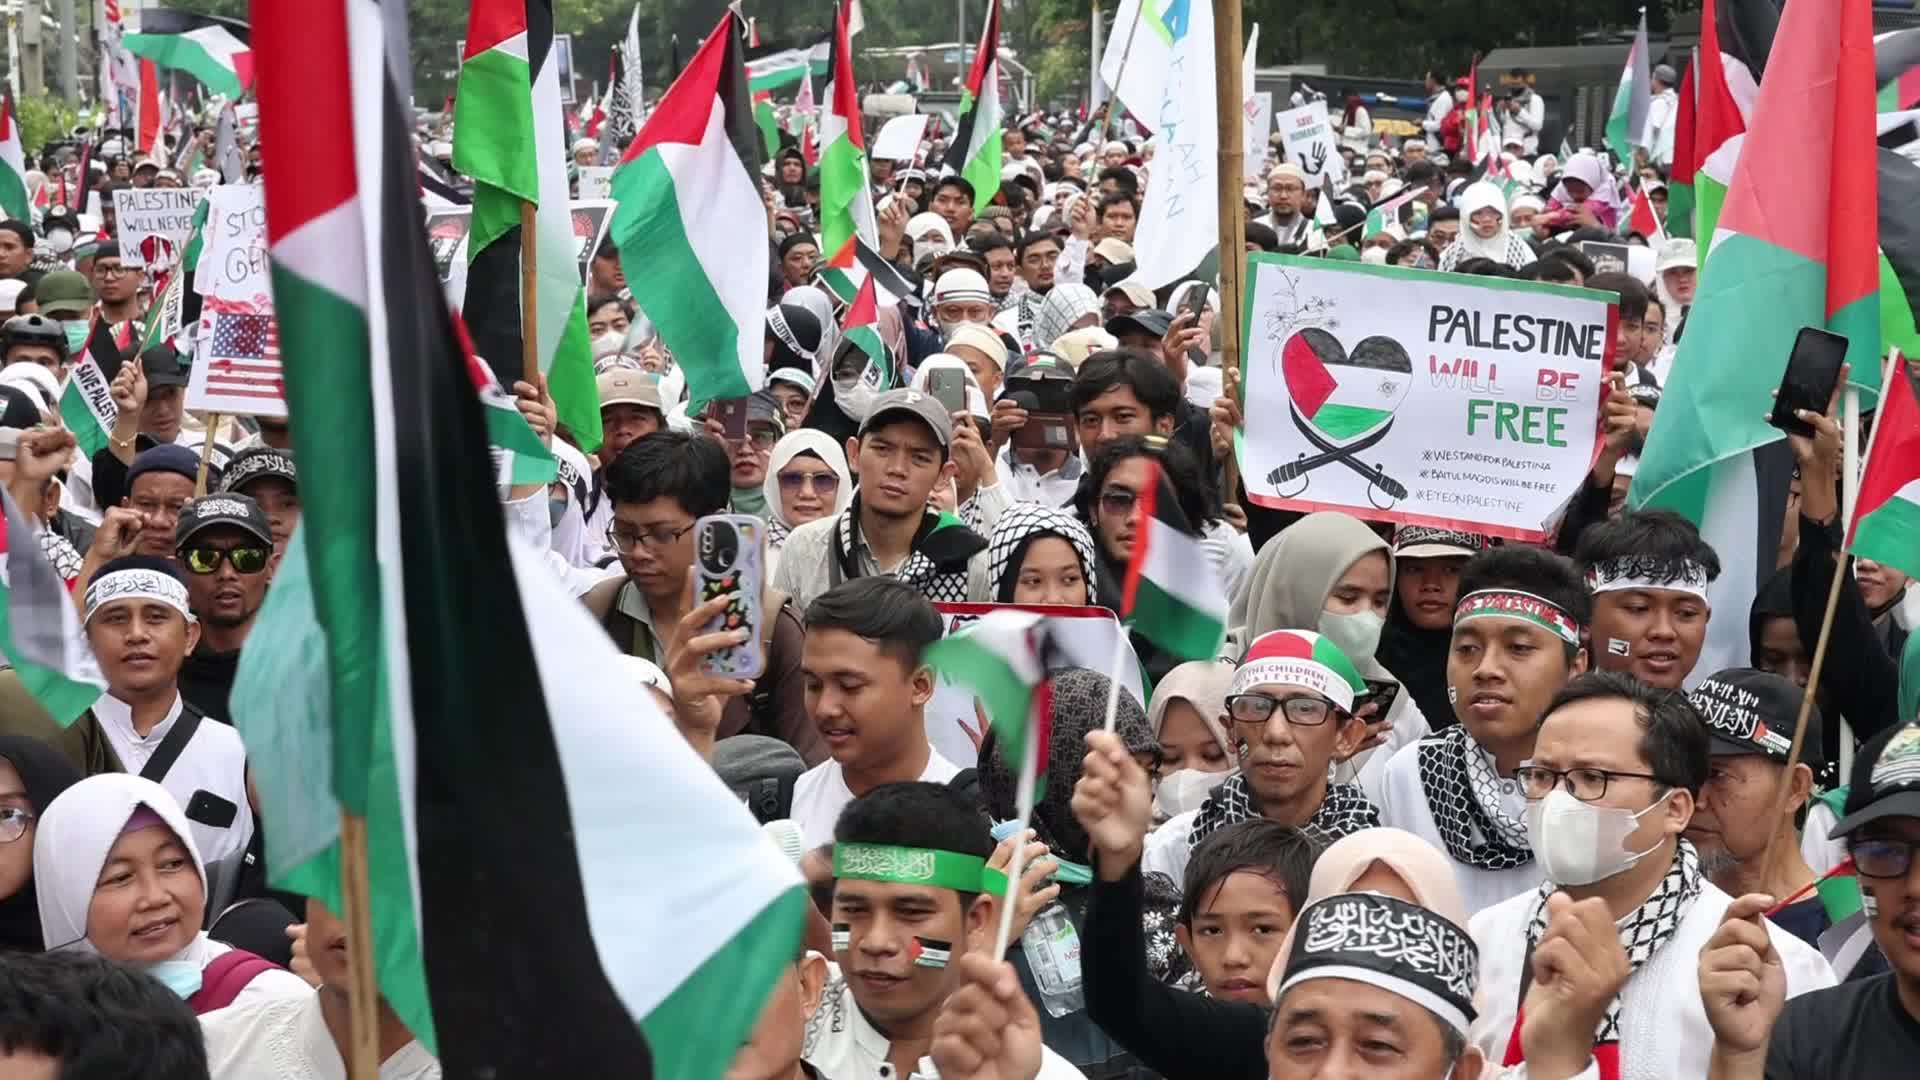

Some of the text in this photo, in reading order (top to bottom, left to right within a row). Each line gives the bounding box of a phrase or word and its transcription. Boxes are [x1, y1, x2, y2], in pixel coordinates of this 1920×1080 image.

[119, 190, 200, 212] PALESTINE
[123, 213, 194, 232] WILL NEVE
[226, 205, 266, 238] STO
[1428, 304, 1605, 360] PALESTINE
[75, 363, 95, 395] SAVE
[1429, 354, 1580, 401] WILL BE
[1466, 399, 1568, 448] FREE
